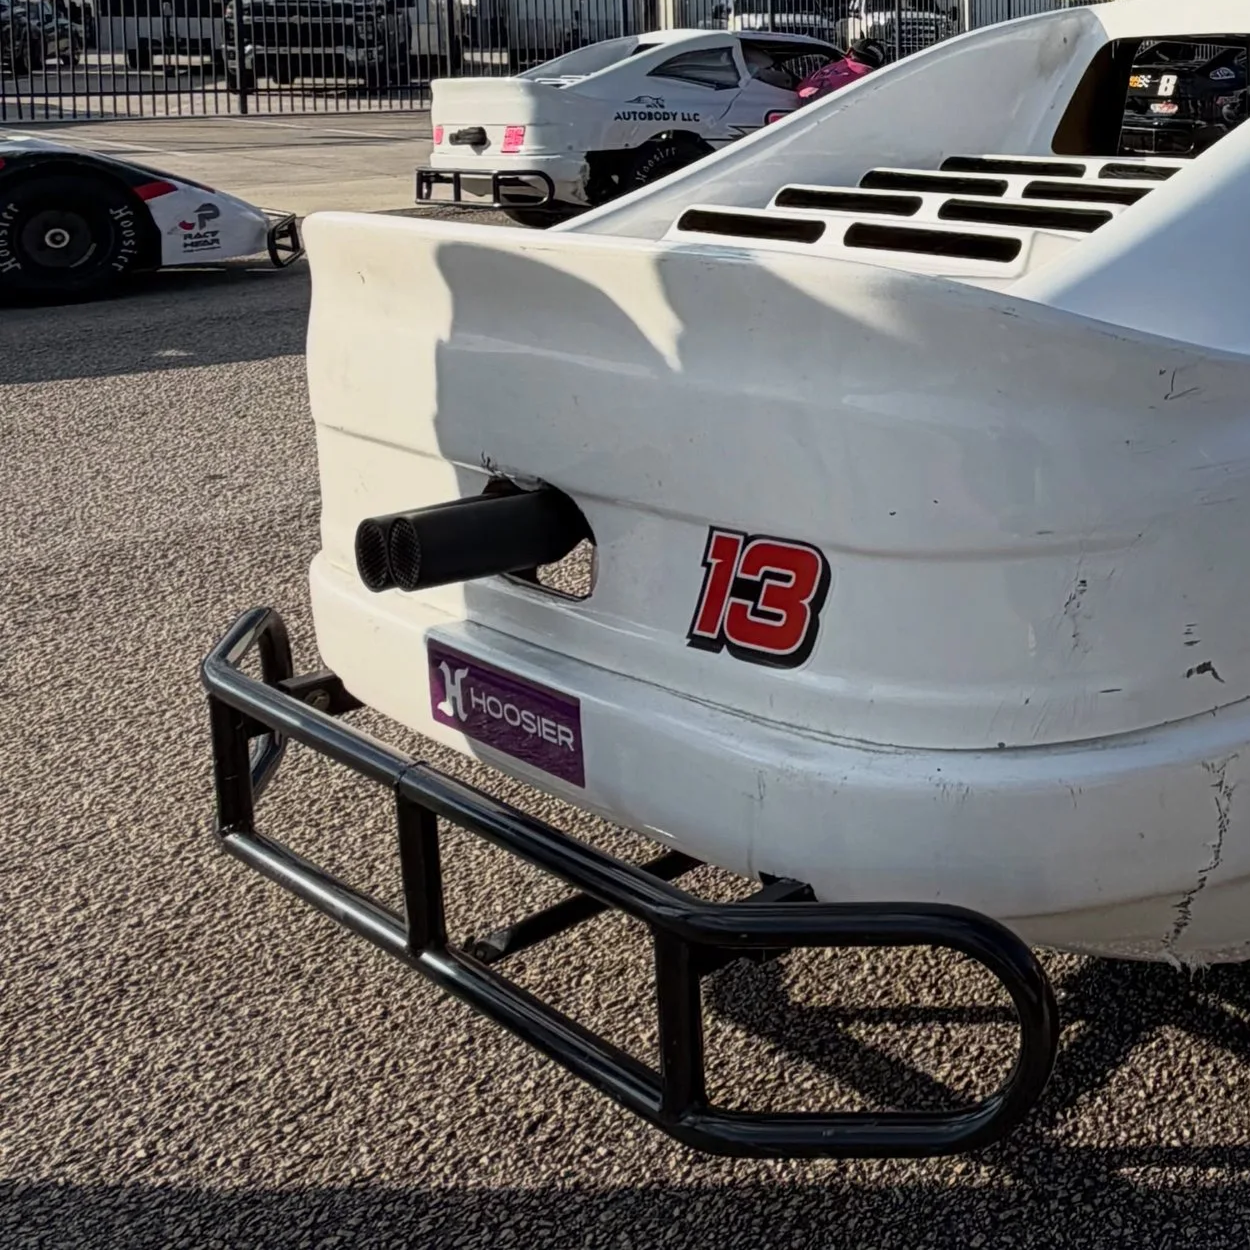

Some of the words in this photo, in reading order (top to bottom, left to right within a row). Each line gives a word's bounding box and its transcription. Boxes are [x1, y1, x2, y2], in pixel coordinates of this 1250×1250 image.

[614, 111, 678, 122] AUTOBODY
[681, 111, 700, 123] LLC
[687, 525, 831, 669] 13
[470, 687, 575, 751] HOOSIER
